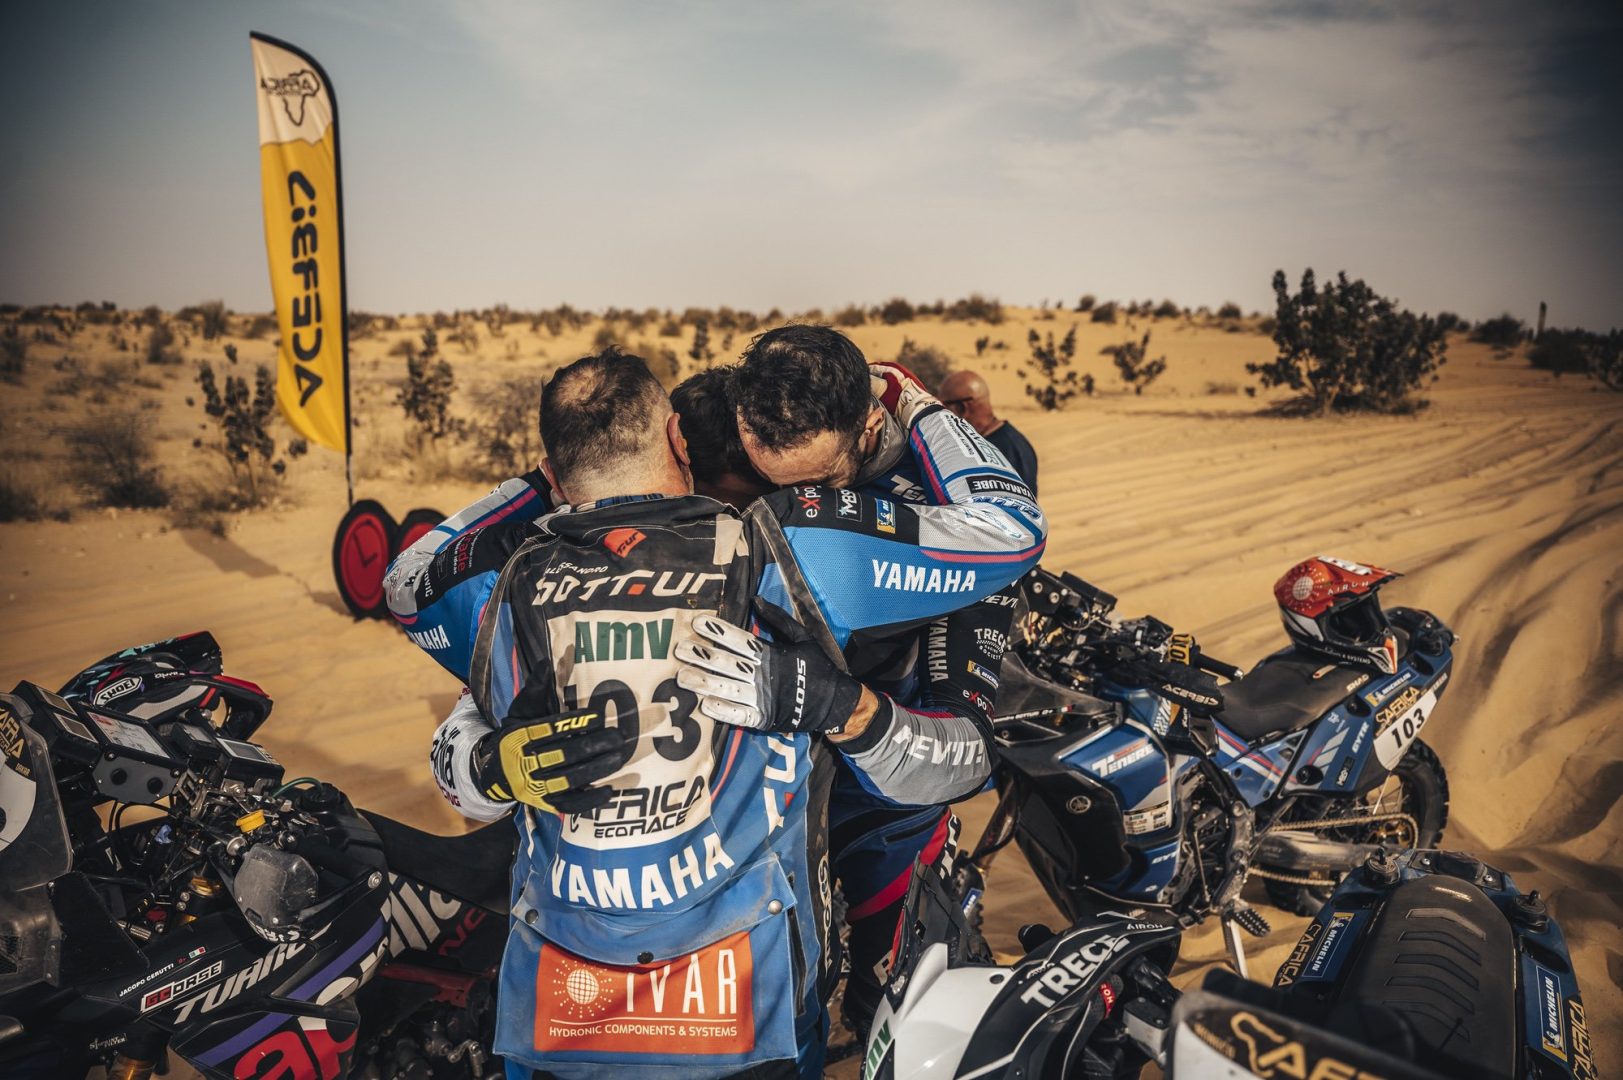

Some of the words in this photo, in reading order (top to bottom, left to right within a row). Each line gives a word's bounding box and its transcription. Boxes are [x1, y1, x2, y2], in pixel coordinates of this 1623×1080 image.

[872, 559, 976, 593] YAMAHA
[100, 679, 135, 703] SHOEI
[791, 657, 807, 729] SCOTT
[1162, 683, 1219, 707] ACERBIS
[1392, 708, 1425, 748] 103
[551, 831, 735, 909] YAMAHA
[1312, 929, 1338, 971] MICHELIN
[119, 979, 146, 998] JACOPO
[146, 962, 174, 981] CERUTTI
[626, 949, 737, 1015] IVAR
[1545, 976, 1558, 1031] MICHELIN
[549, 1024, 602, 1037] HYDRONIC
[604, 1023, 675, 1036] COMPONENTS
[678, 1025, 687, 1036] &
[688, 1026, 737, 1037] SYSTEMS
